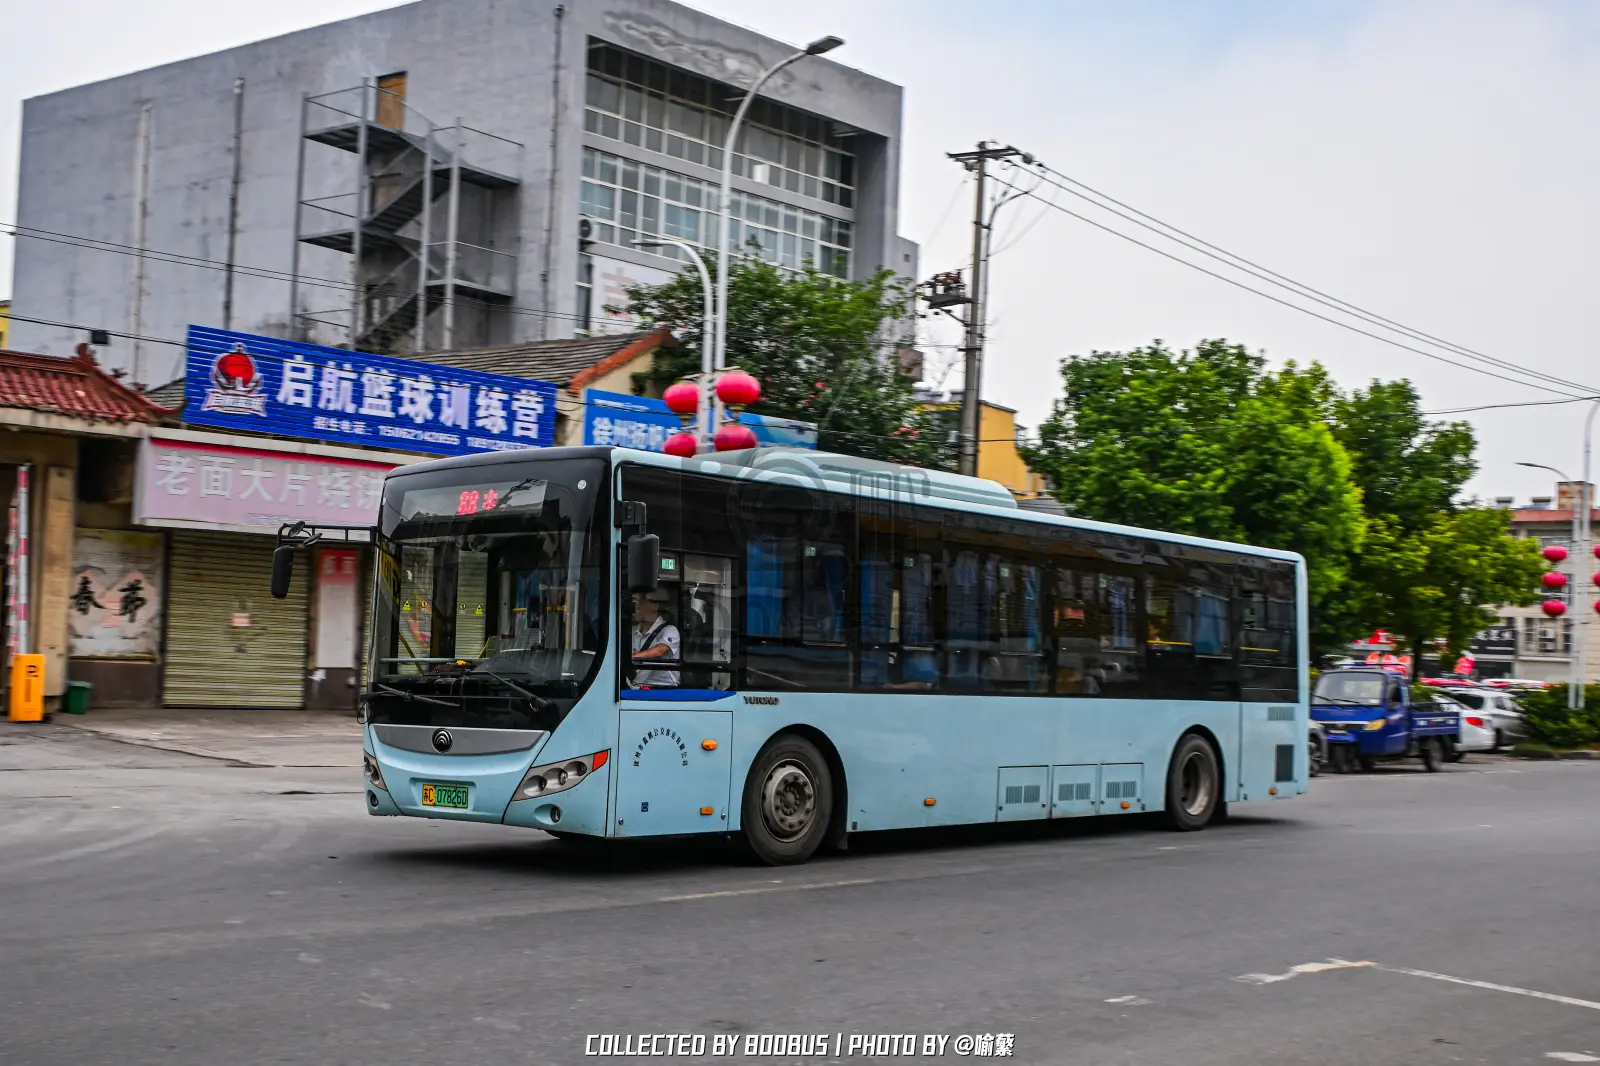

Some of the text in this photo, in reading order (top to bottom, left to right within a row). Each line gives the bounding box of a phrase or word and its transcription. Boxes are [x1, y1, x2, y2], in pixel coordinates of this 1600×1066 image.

[277, 355, 545, 439] 启航篮球训练营
